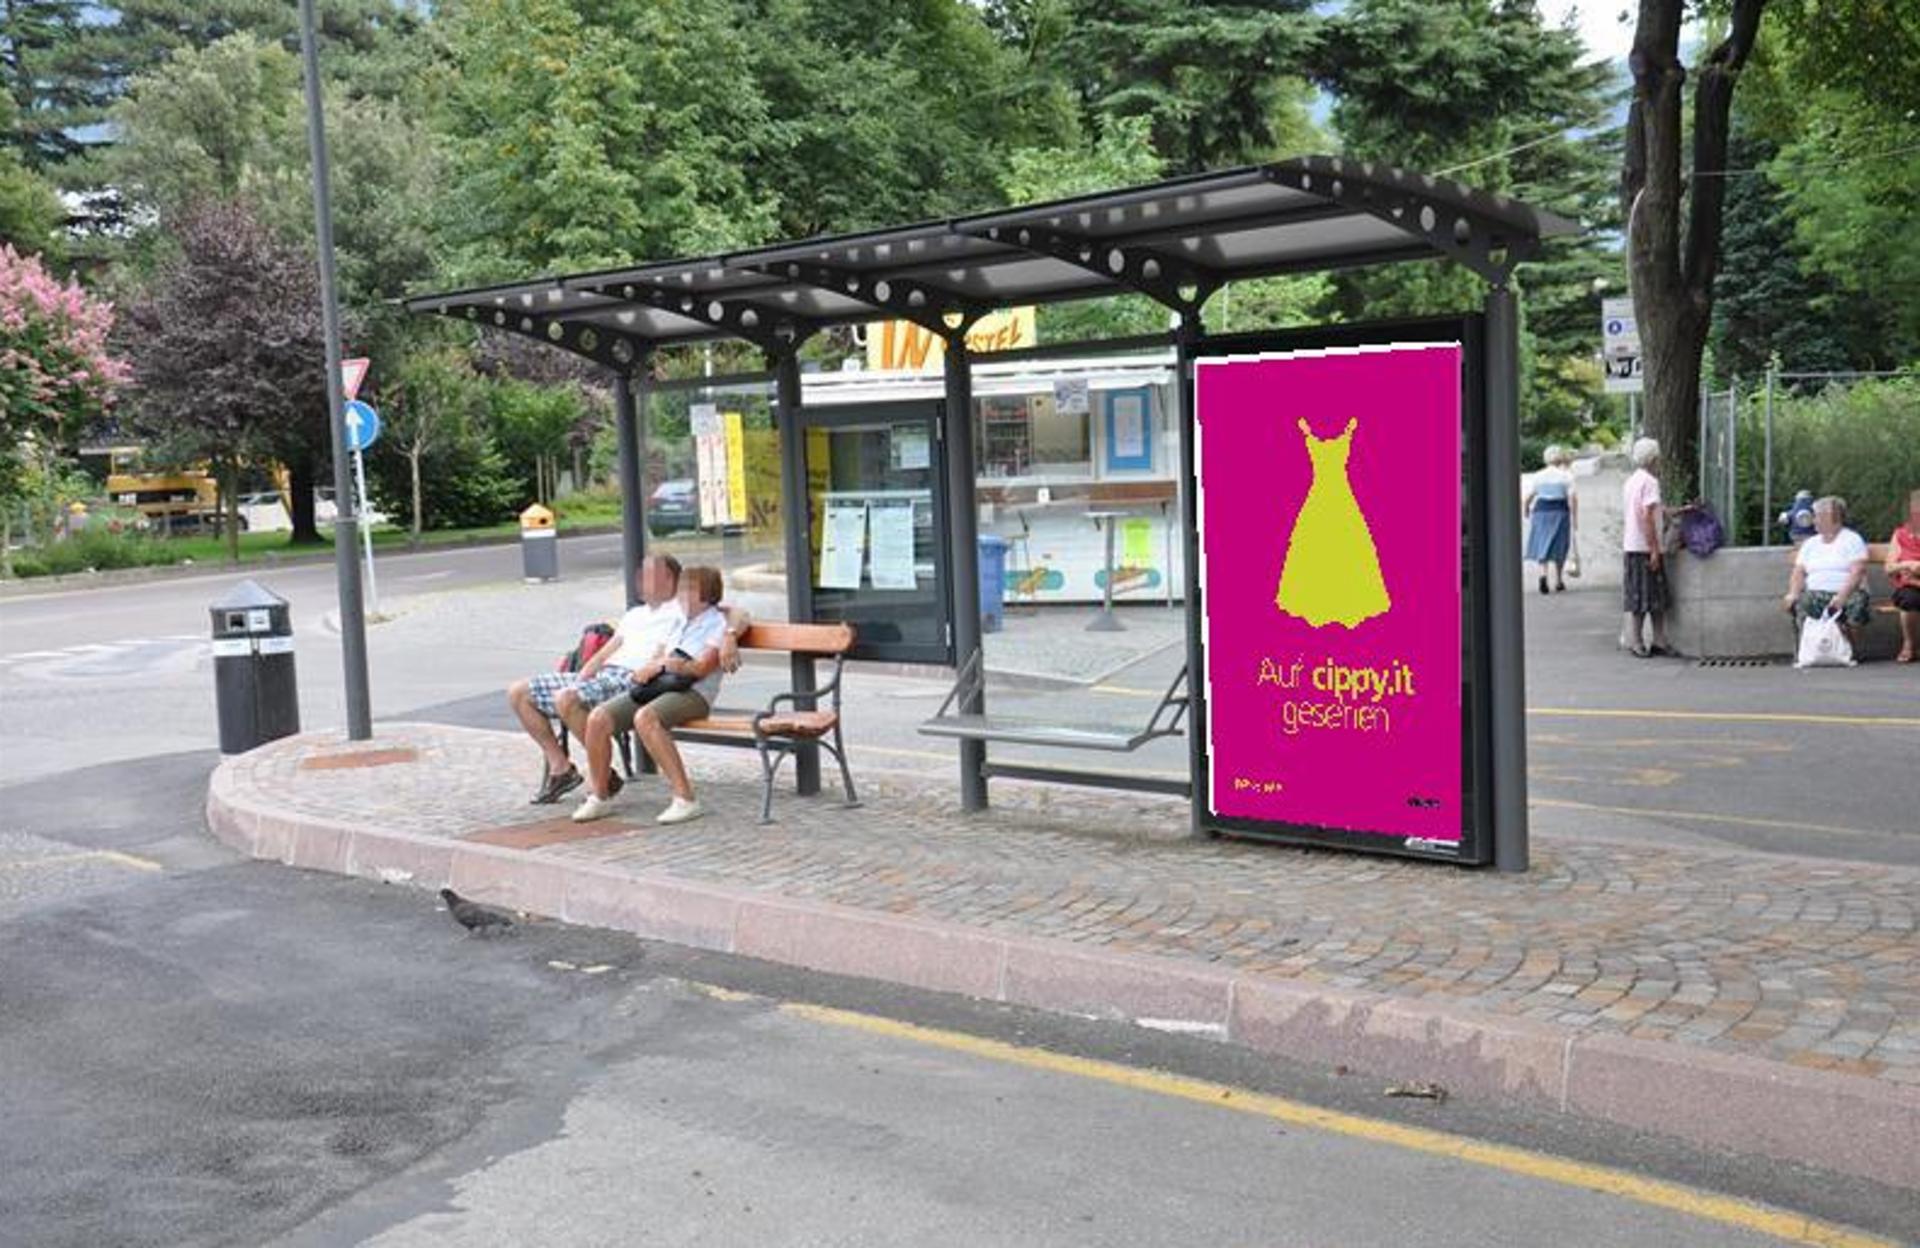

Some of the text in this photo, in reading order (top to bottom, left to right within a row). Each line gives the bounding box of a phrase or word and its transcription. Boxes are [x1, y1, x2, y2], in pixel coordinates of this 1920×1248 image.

[1257, 653, 1416, 702] Auf cippy.it
[1282, 698, 1390, 734] gesehen
